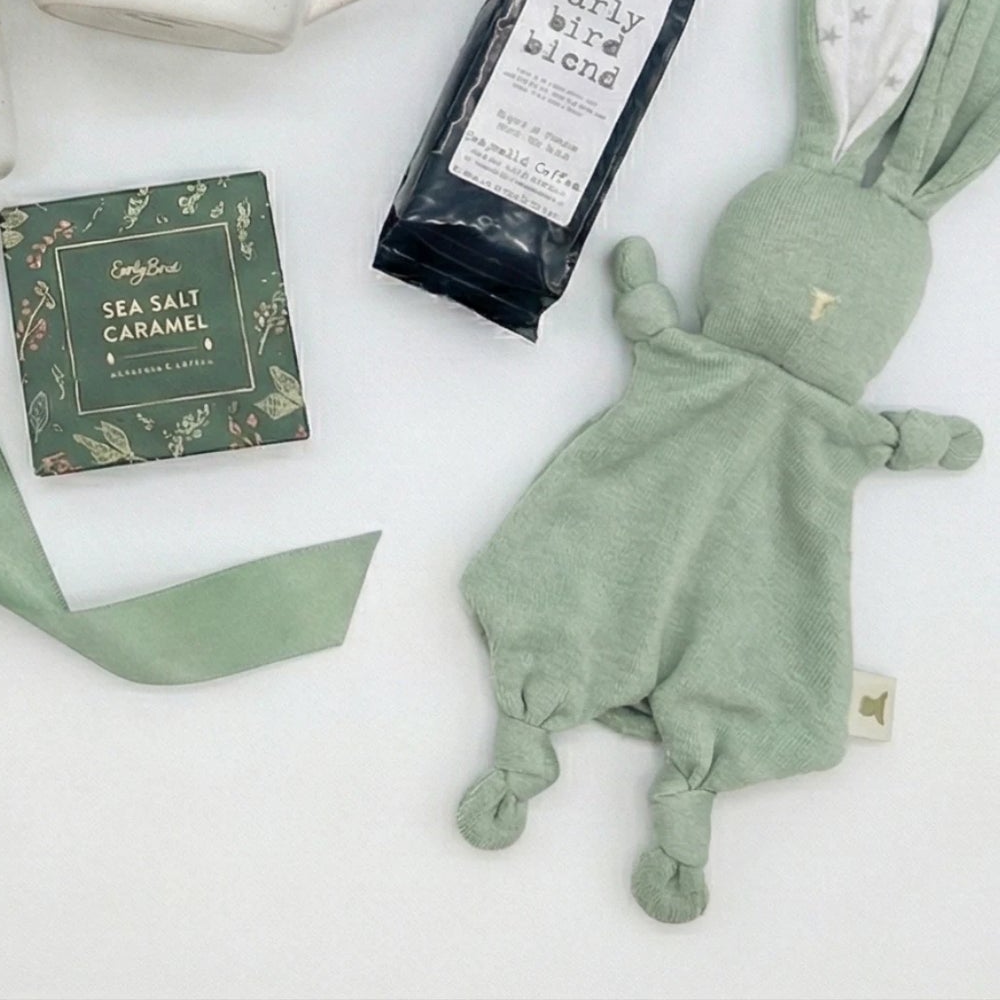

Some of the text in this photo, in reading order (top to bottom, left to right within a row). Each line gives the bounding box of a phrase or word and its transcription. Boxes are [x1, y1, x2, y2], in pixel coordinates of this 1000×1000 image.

[548, 4, 624, 58] bird
[102, 289, 199, 319] SEA SALT
[103, 314, 208, 342] CARAMEL
